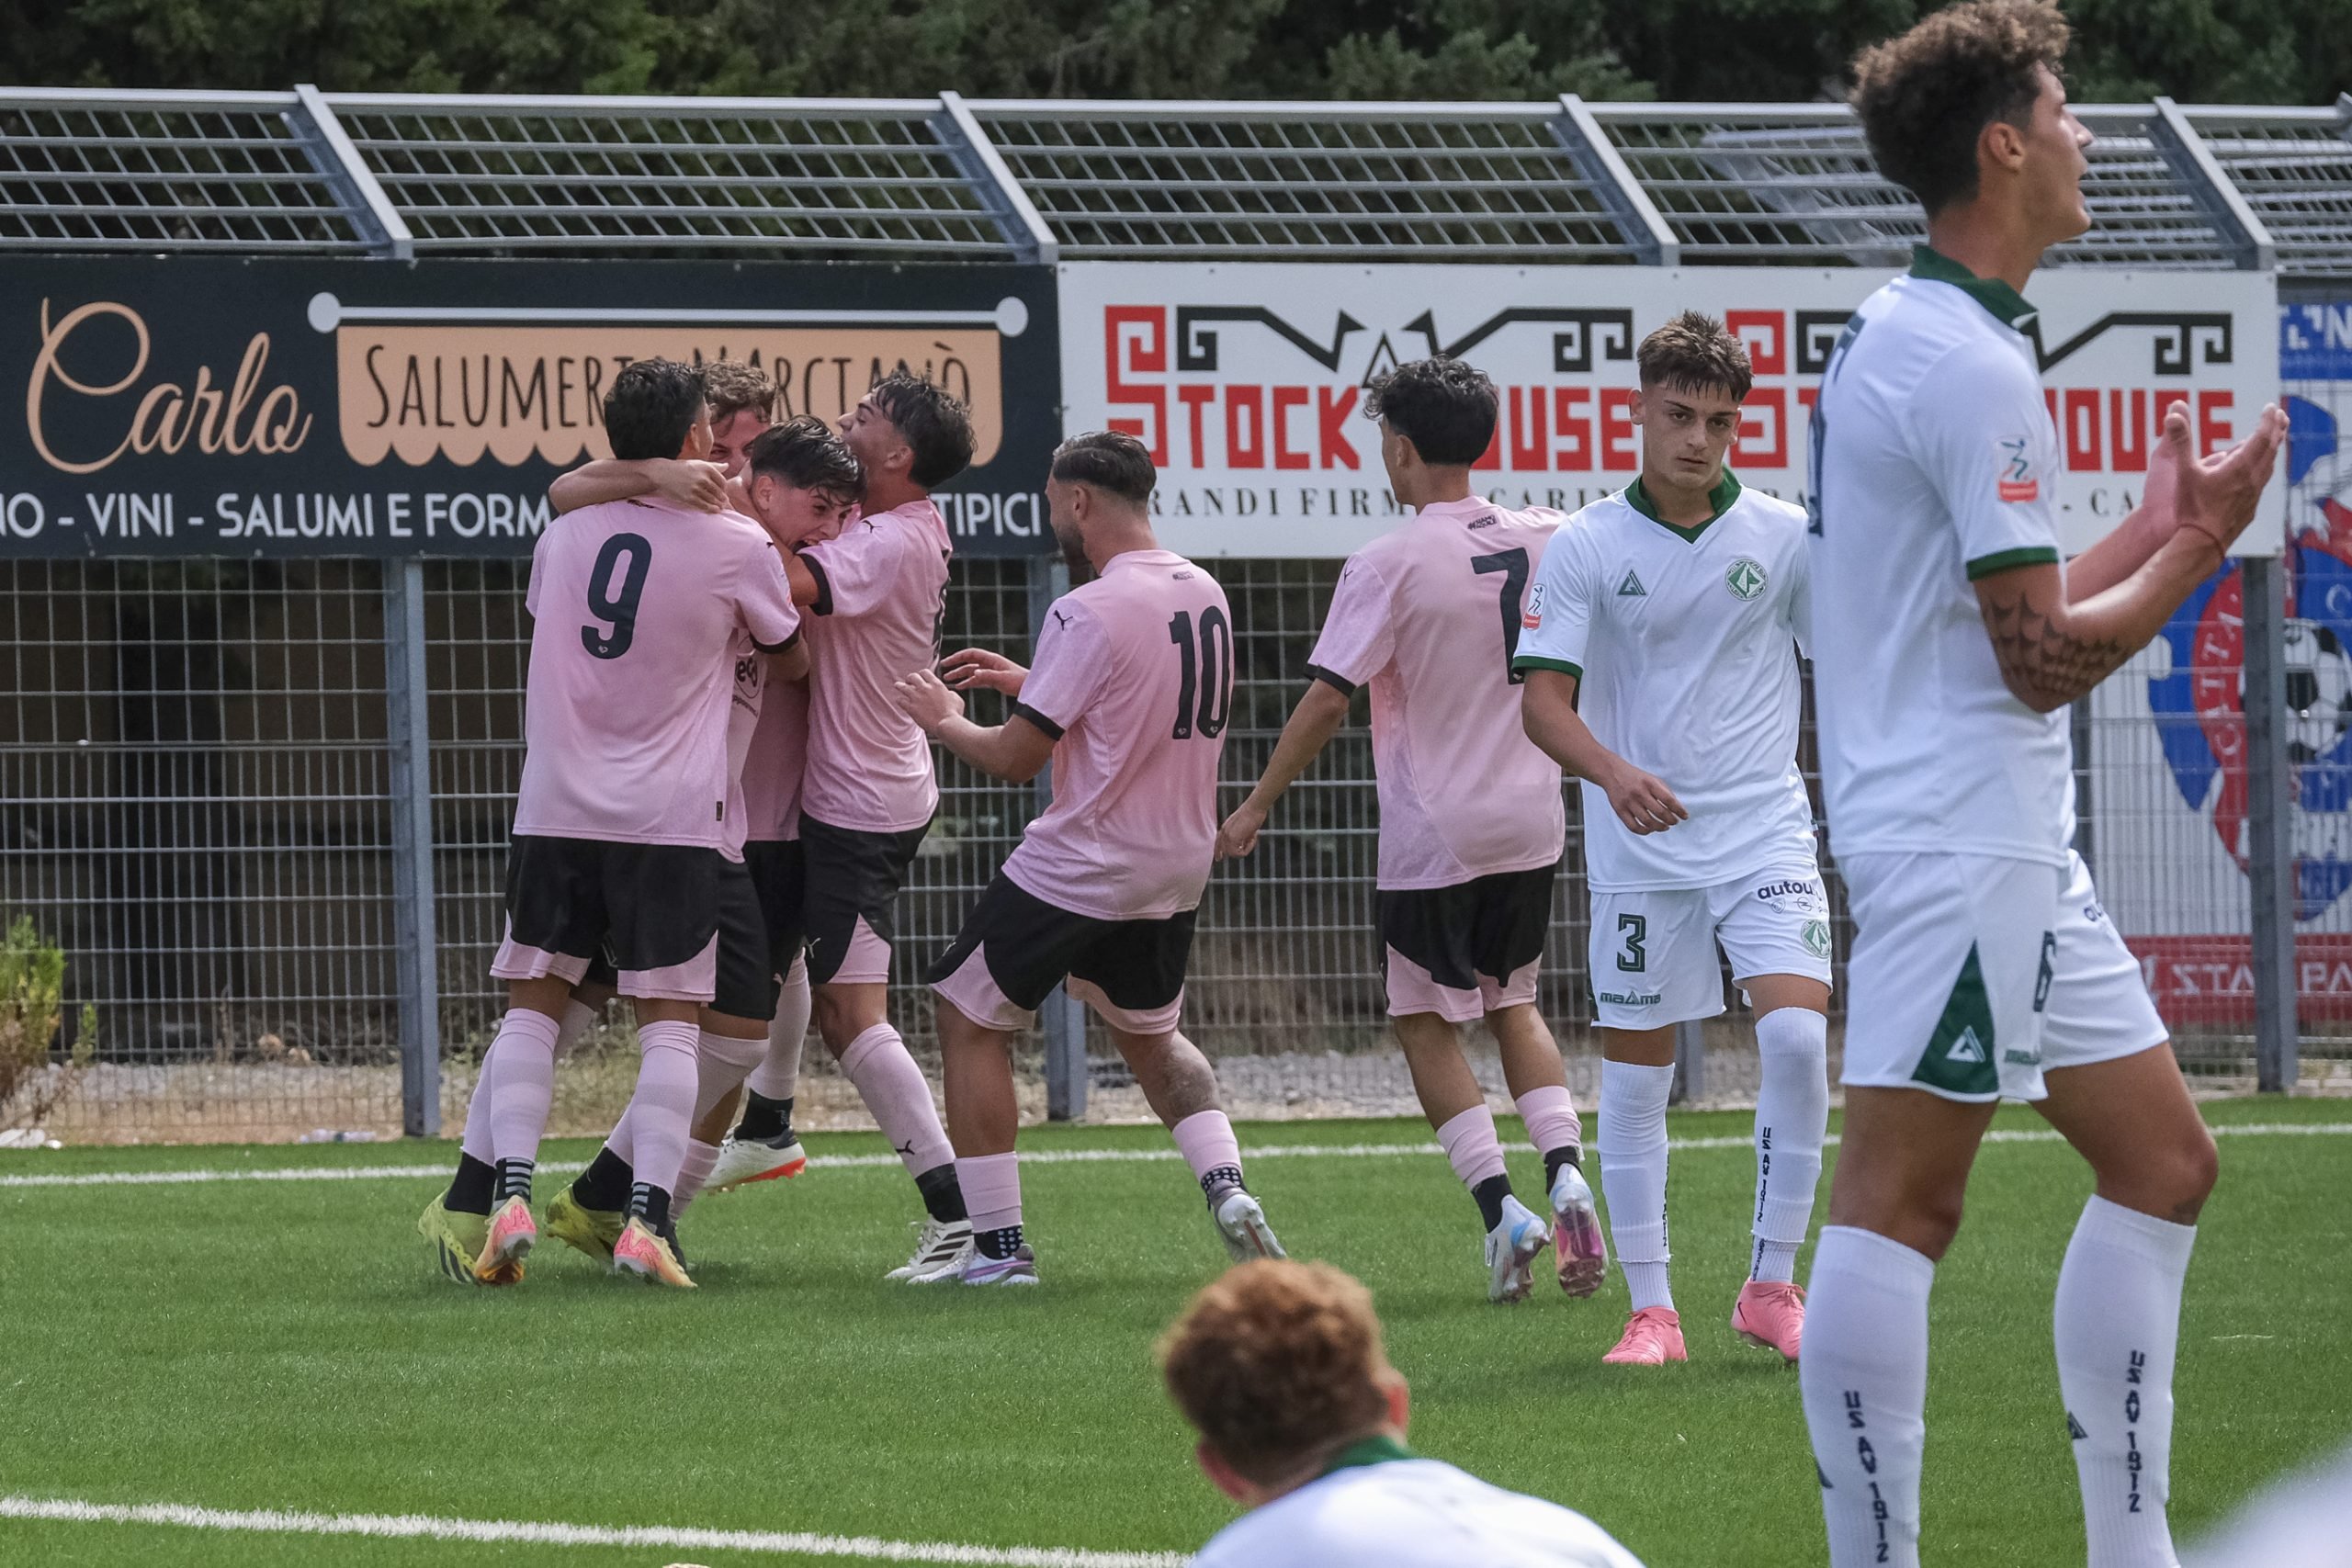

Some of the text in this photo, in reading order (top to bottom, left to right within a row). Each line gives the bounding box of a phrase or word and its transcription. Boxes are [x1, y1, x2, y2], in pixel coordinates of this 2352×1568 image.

[27, 297, 313, 474] Carlo
[367, 344, 634, 429] SALUMER
[1105, 305, 1361, 469] STOCK
[1470, 387, 1639, 470] USE
[2044, 389, 2236, 471] OUE
[85, 492, 174, 537] VINI
[216, 493, 373, 537] SALUMI
[388, 493, 413, 537] E
[425, 493, 551, 537] FORM
[929, 492, 1042, 537] TIPICI
[1148, 487, 1279, 516] RANDI
[1300, 488, 1406, 516] FIRM
[581, 533, 652, 660] 9
[1470, 547, 1530, 685] 7
[1169, 604, 1231, 740] 10
[1617, 913, 1646, 973] 3
[2033, 931, 2058, 1012] 6
[2171, 961, 2352, 997] STAPA
[1844, 1390, 1890, 1564] US AV 1912
[2125, 1350, 2145, 1513] US AV 1912
